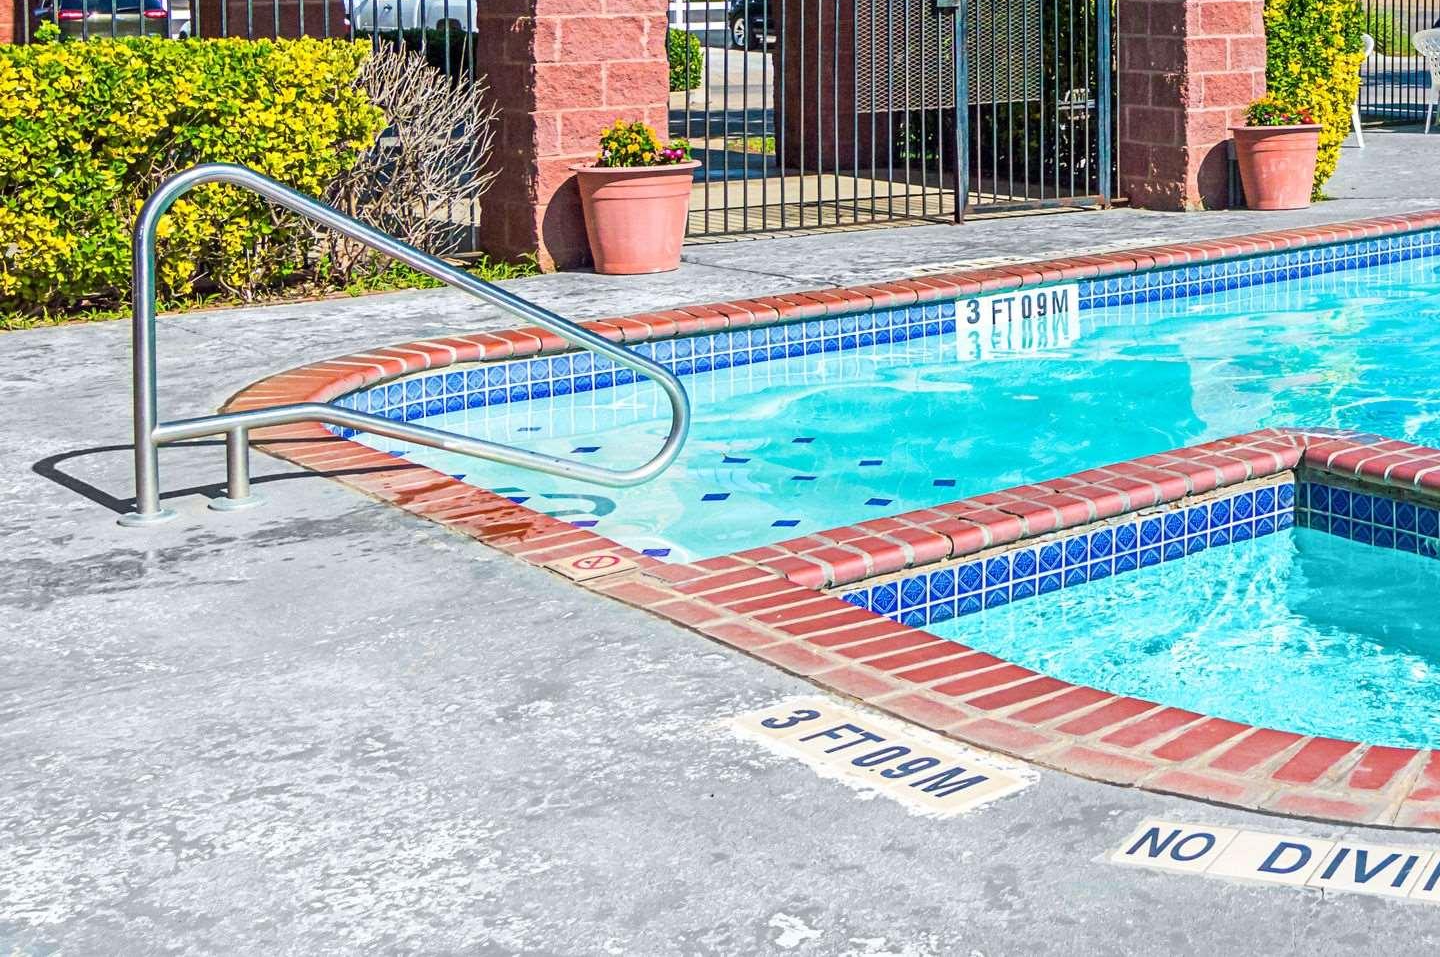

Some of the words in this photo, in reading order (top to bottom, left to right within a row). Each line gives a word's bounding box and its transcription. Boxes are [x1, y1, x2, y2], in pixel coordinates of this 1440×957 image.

[966, 299, 981, 324] 3
[760, 709, 822, 729] 3
[1126, 827, 1217, 862] NO
